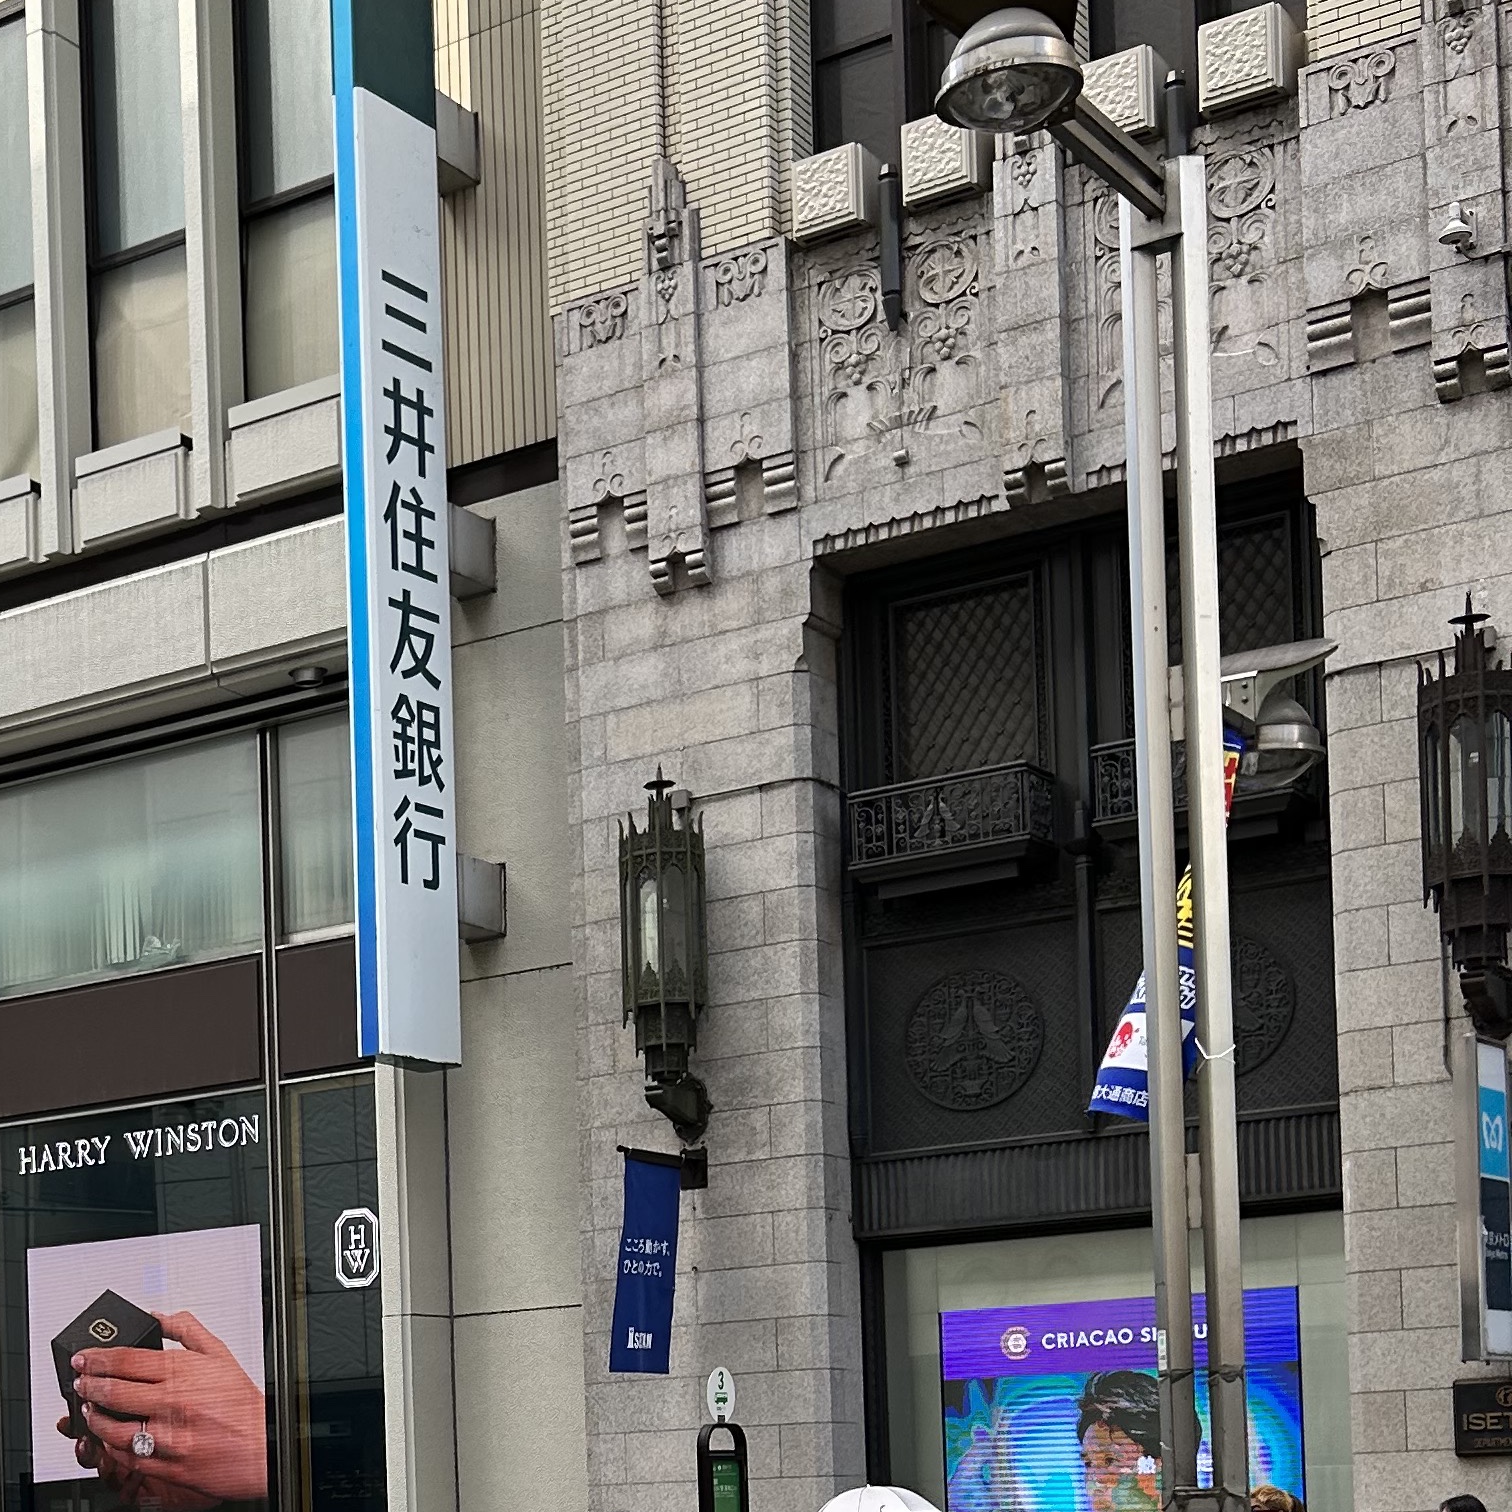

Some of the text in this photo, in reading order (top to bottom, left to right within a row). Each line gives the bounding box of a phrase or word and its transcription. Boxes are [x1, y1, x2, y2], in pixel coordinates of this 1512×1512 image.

[381, 269, 447, 891] 三井住友銀行
[18, 1114, 260, 1175] HARRY WINSTON
[1041, 1328, 1134, 1350] CRIACAO
[718, 1371, 724, 1390] 3
